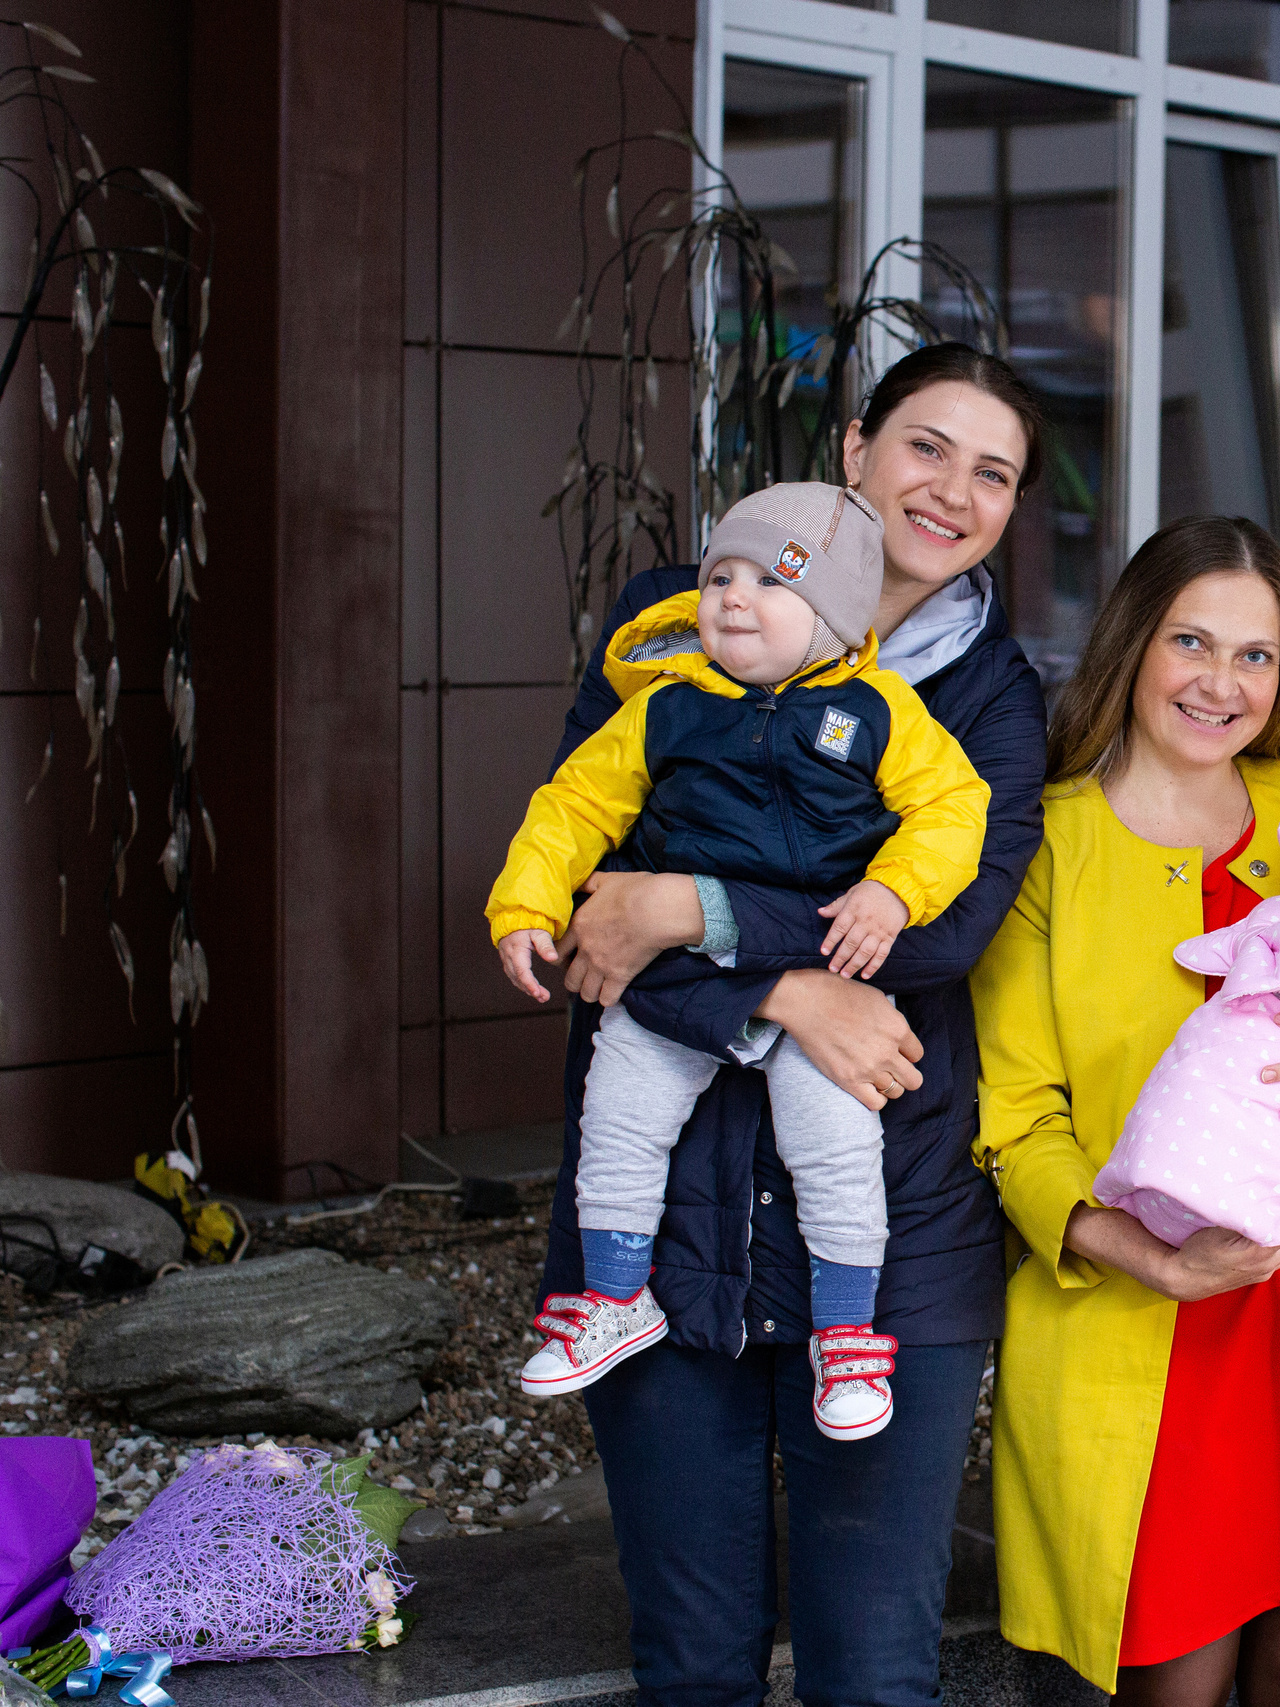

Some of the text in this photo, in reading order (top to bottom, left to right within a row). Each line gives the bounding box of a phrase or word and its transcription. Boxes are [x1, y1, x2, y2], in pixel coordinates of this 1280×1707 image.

[826, 711, 857, 732] MAKE
[823, 722, 853, 744] SOME
[820, 733, 849, 755] NOISE
[612, 1250, 649, 1262] sea
